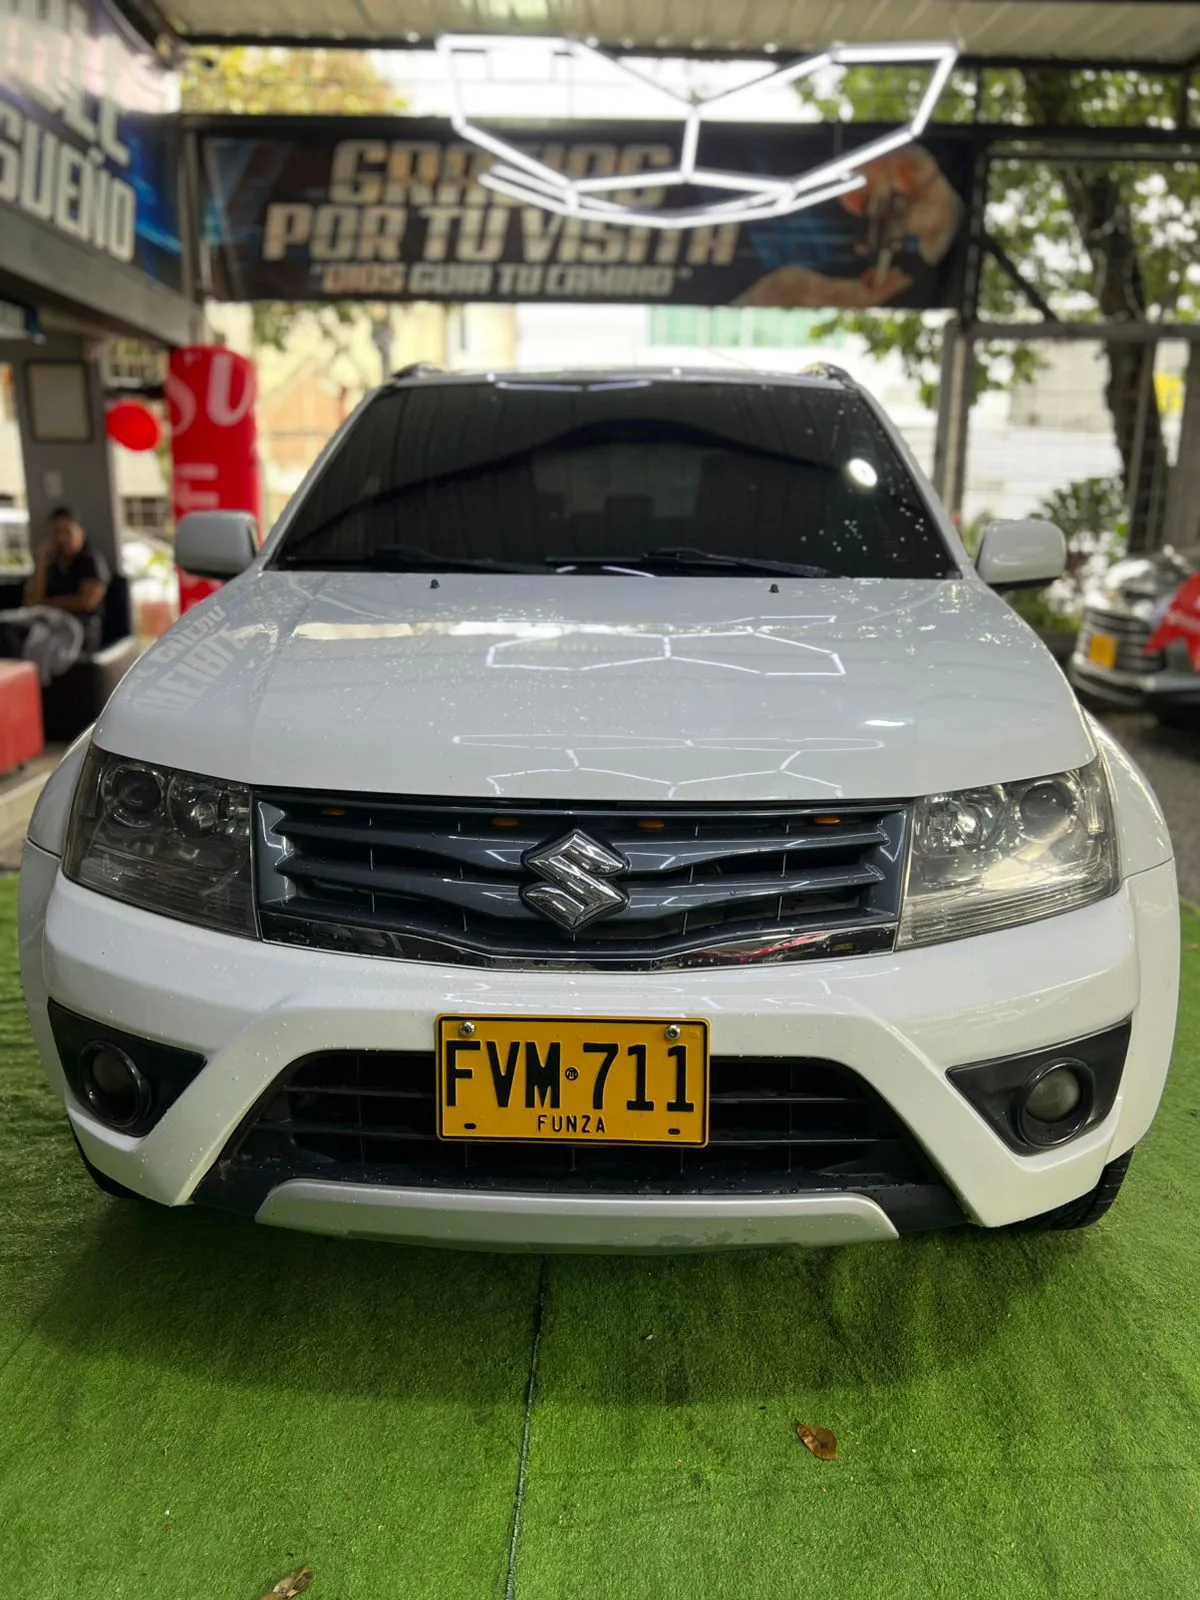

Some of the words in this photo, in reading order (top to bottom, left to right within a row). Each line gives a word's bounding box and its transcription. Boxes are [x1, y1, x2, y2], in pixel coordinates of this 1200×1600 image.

[330, 139, 672, 208] GRAIAS
[263, 203, 406, 262] POR
[421, 206, 510, 262] TU
[497, 265, 543, 295] TU
[446, 1041, 561, 1109] FVM
[582, 1042, 695, 1112] 711
[537, 1114, 606, 1134] FUNZA
